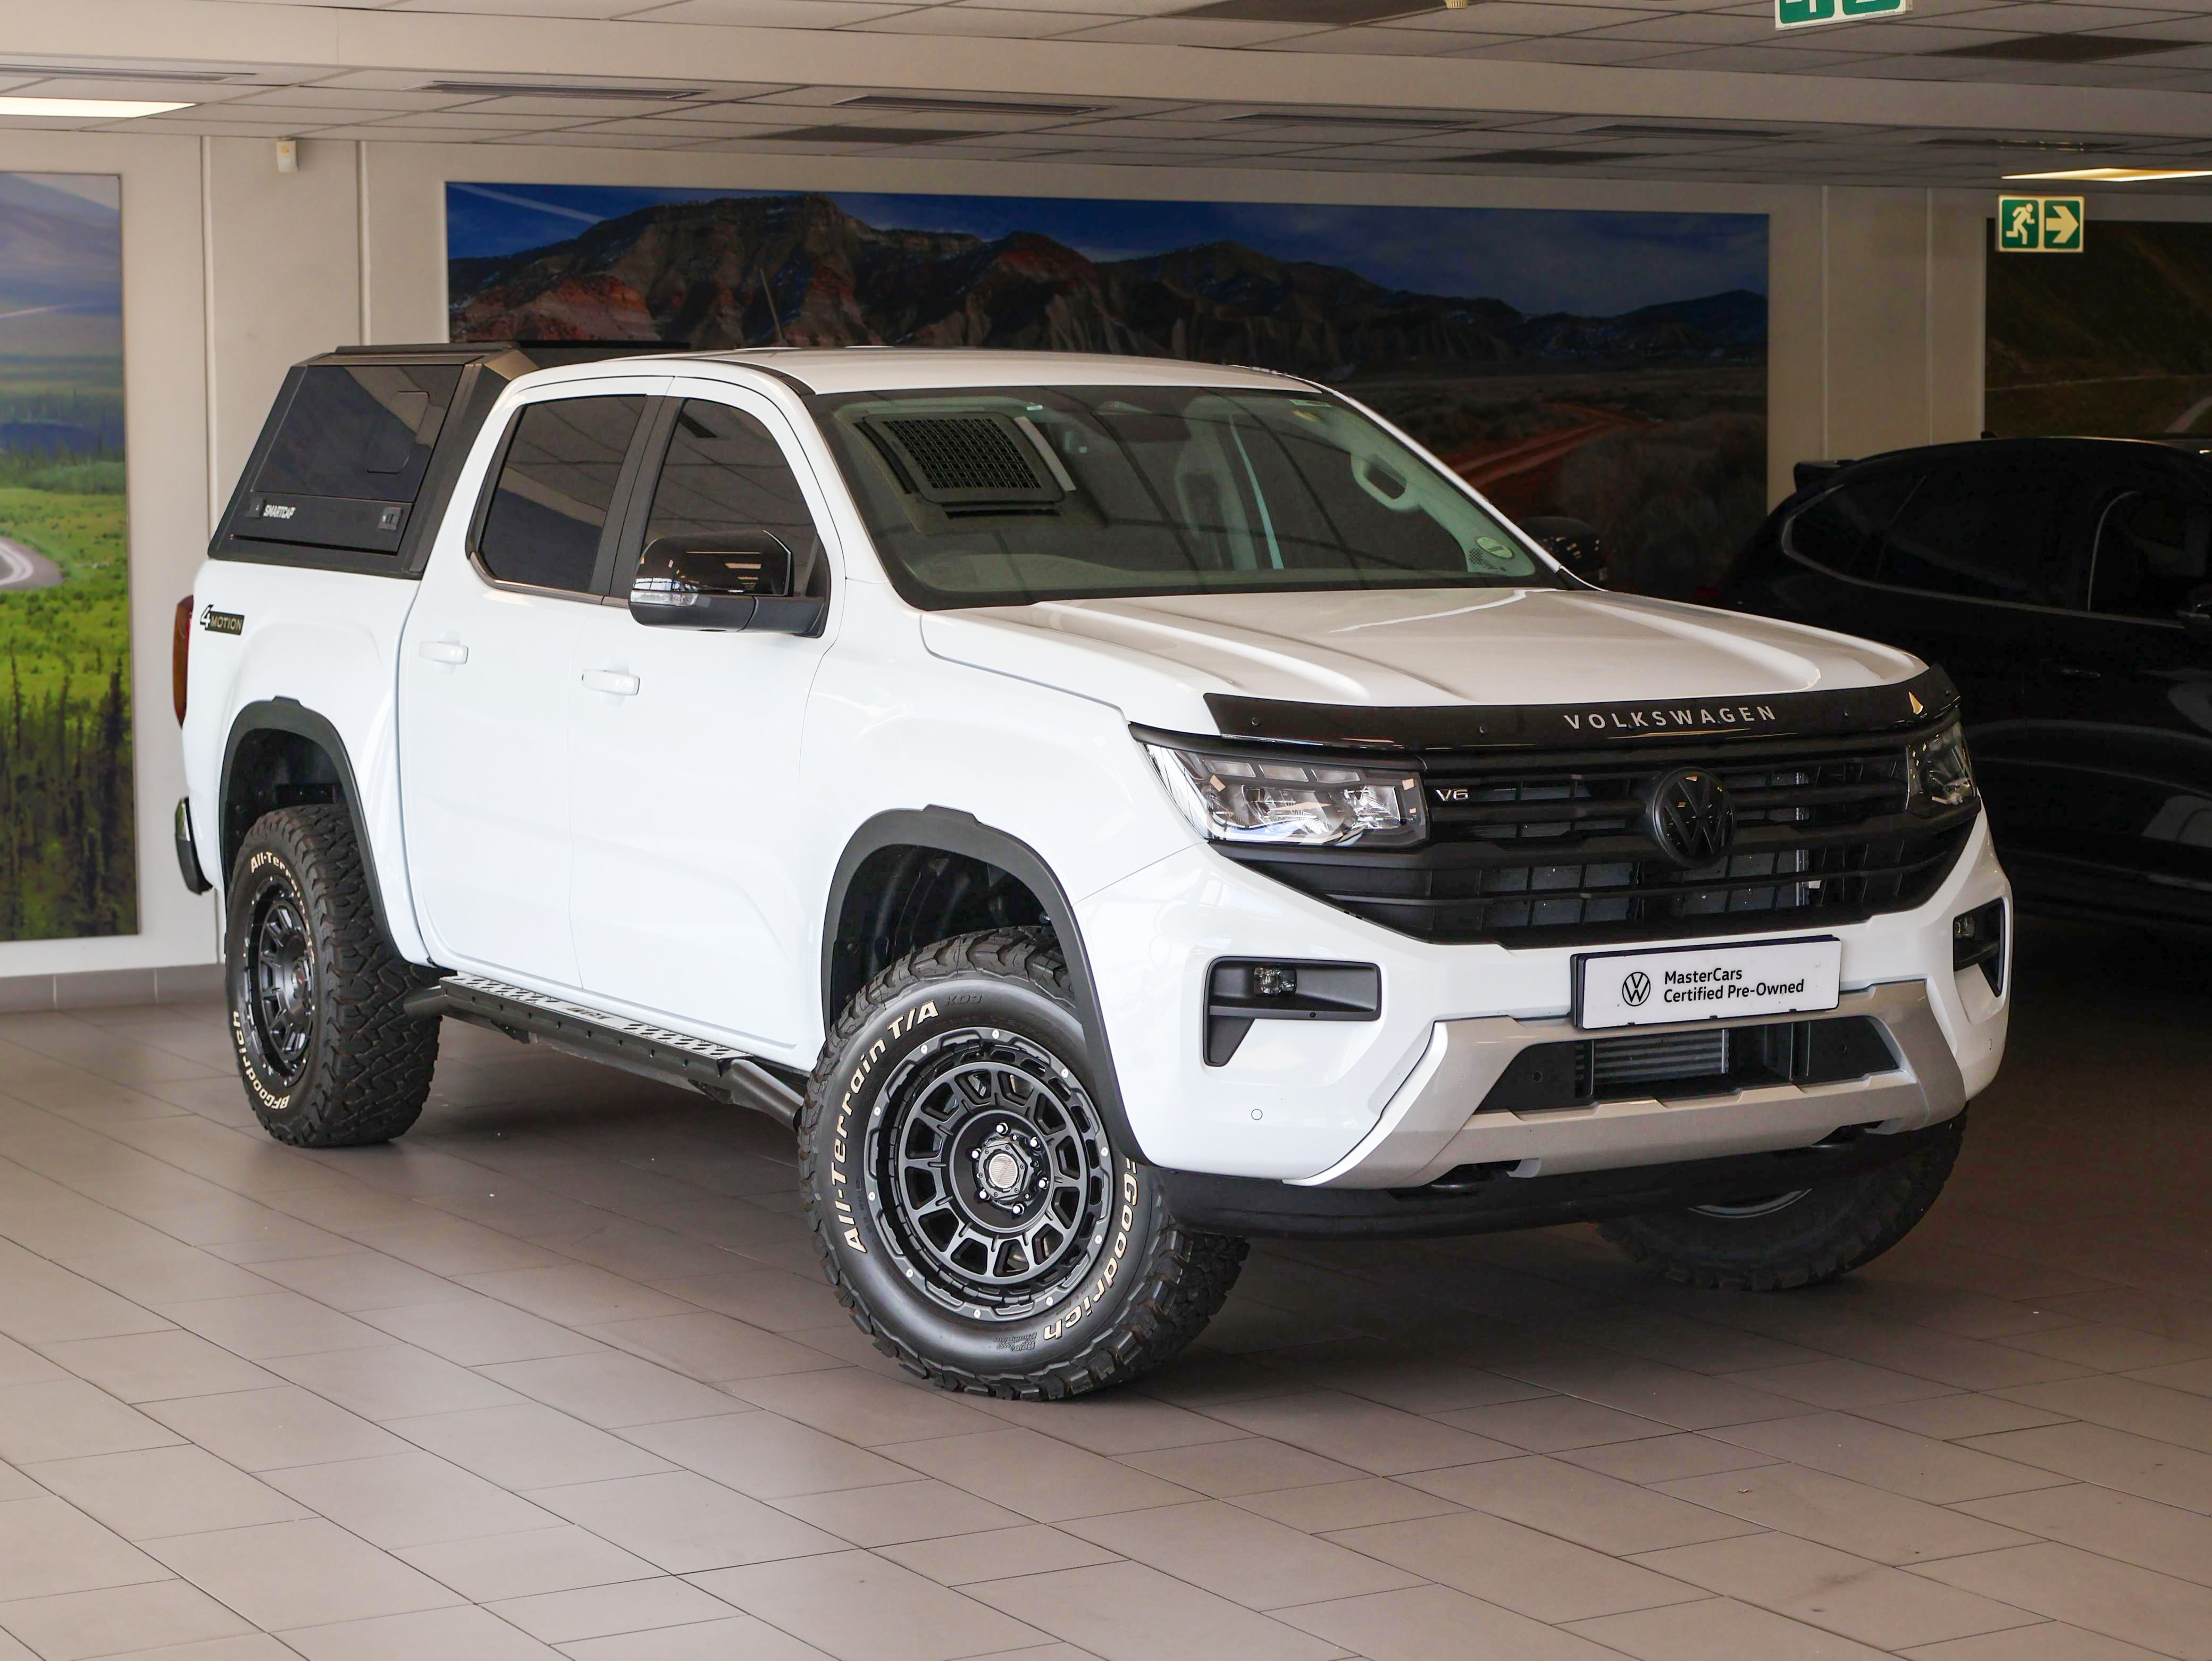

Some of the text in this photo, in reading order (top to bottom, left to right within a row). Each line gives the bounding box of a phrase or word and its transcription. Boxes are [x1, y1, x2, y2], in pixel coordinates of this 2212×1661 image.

[263, 504, 296, 519] SMARTCAP
[200, 605, 242, 631] 4MOTION
[1563, 706, 1776, 729] VOLKSWAGEN
[1436, 788, 1469, 801] V6
[1664, 968, 1742, 985] MasterCars
[1664, 978, 1805, 1003] Certified Pre-Owned
[232, 1010, 290, 1110] BFGoodrich
[831, 1038, 887, 1253] All-Terrain
[887, 1000, 940, 1041] T/A
